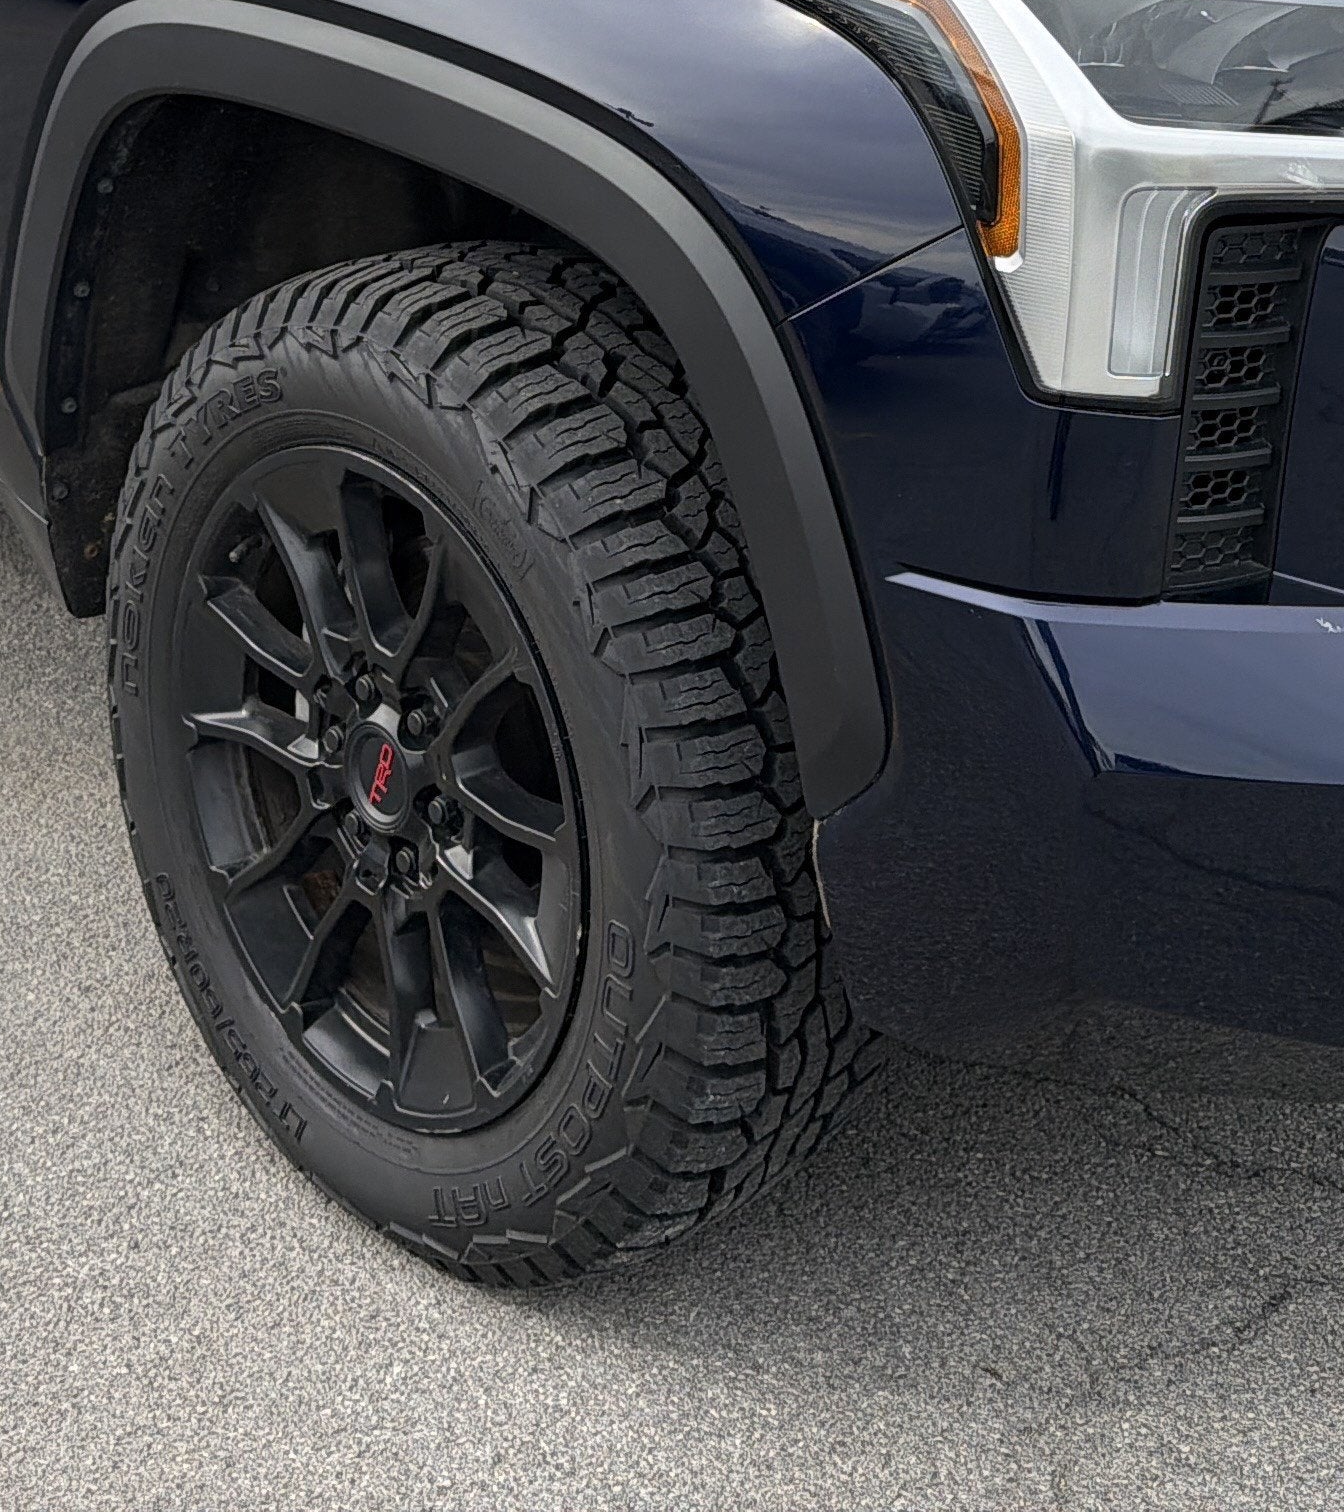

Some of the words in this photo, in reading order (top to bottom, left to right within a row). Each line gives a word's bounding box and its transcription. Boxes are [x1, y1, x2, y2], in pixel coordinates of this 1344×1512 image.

[166, 367, 284, 470] TYRES
[369, 743, 393, 804] TRD
[519, 918, 635, 1208] OUTPOST
